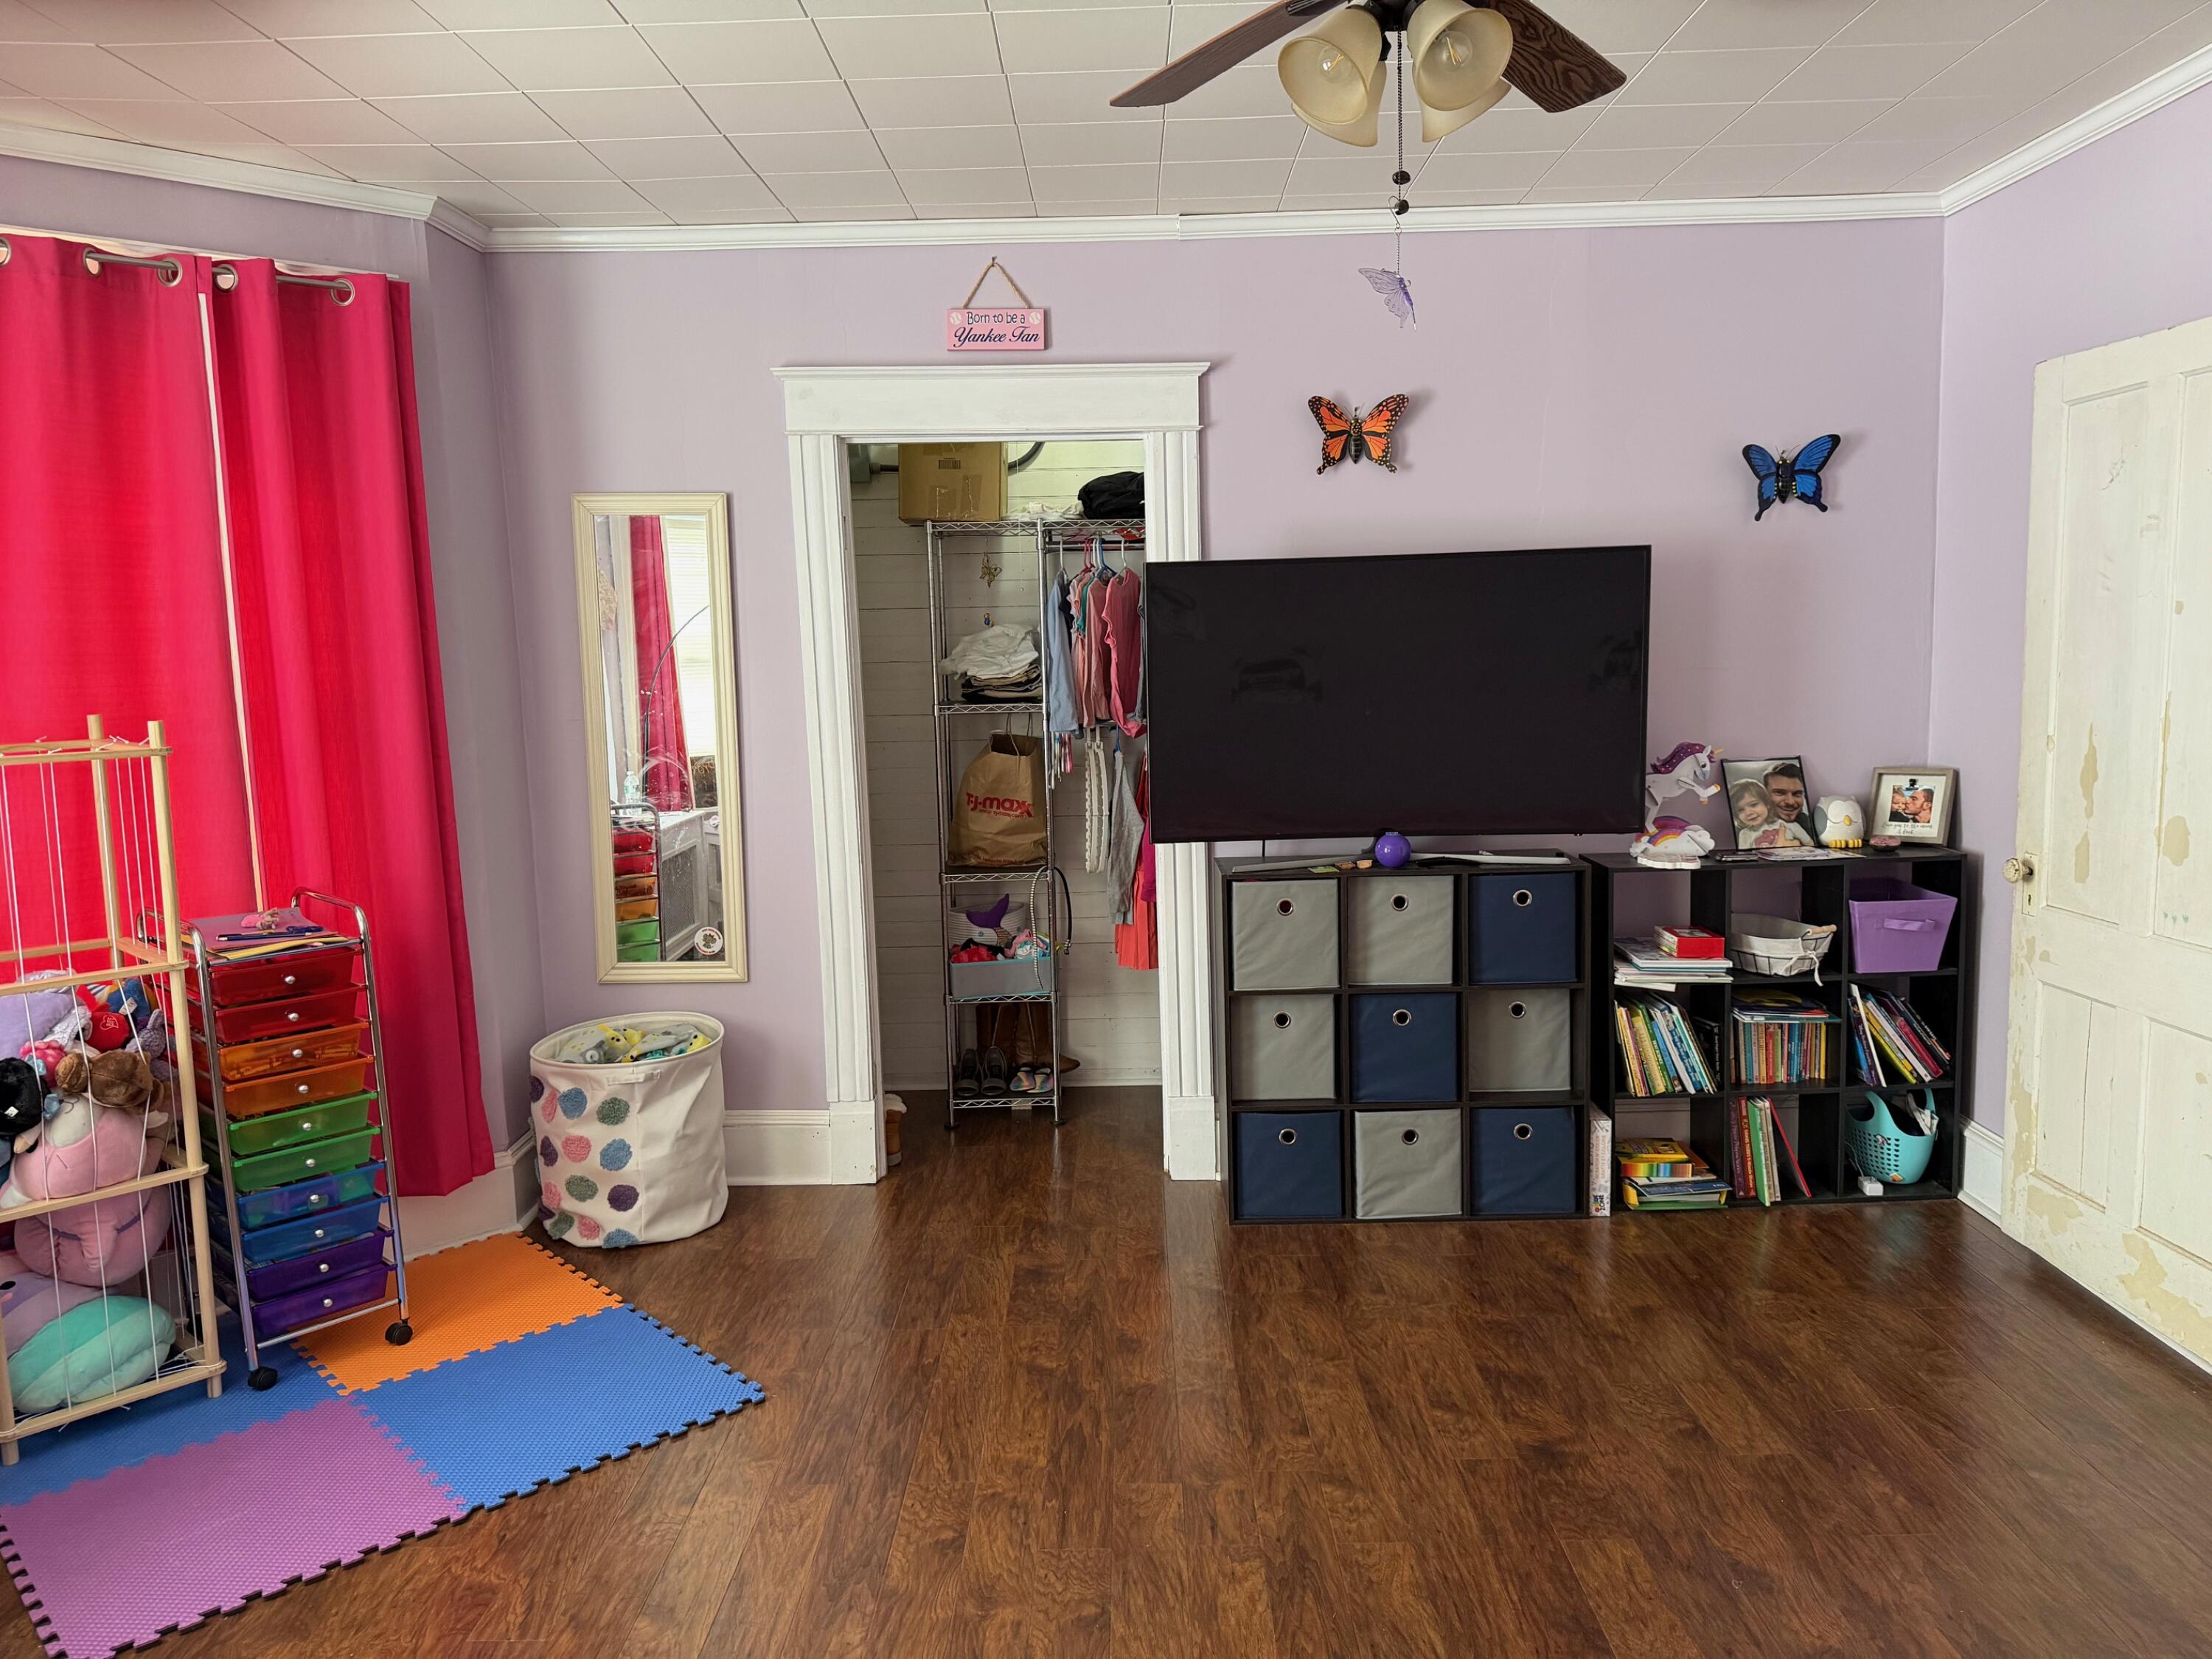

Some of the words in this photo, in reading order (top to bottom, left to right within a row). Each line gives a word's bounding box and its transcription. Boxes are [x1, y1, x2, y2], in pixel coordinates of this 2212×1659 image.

[967, 311, 990, 325] Born
[992, 313, 1004, 323] to
[1006, 313, 1018, 324] be
[1020, 314, 1026, 324] a
[953, 327, 1007, 348] Yankee
[1009, 326, 1040, 343] Fan
